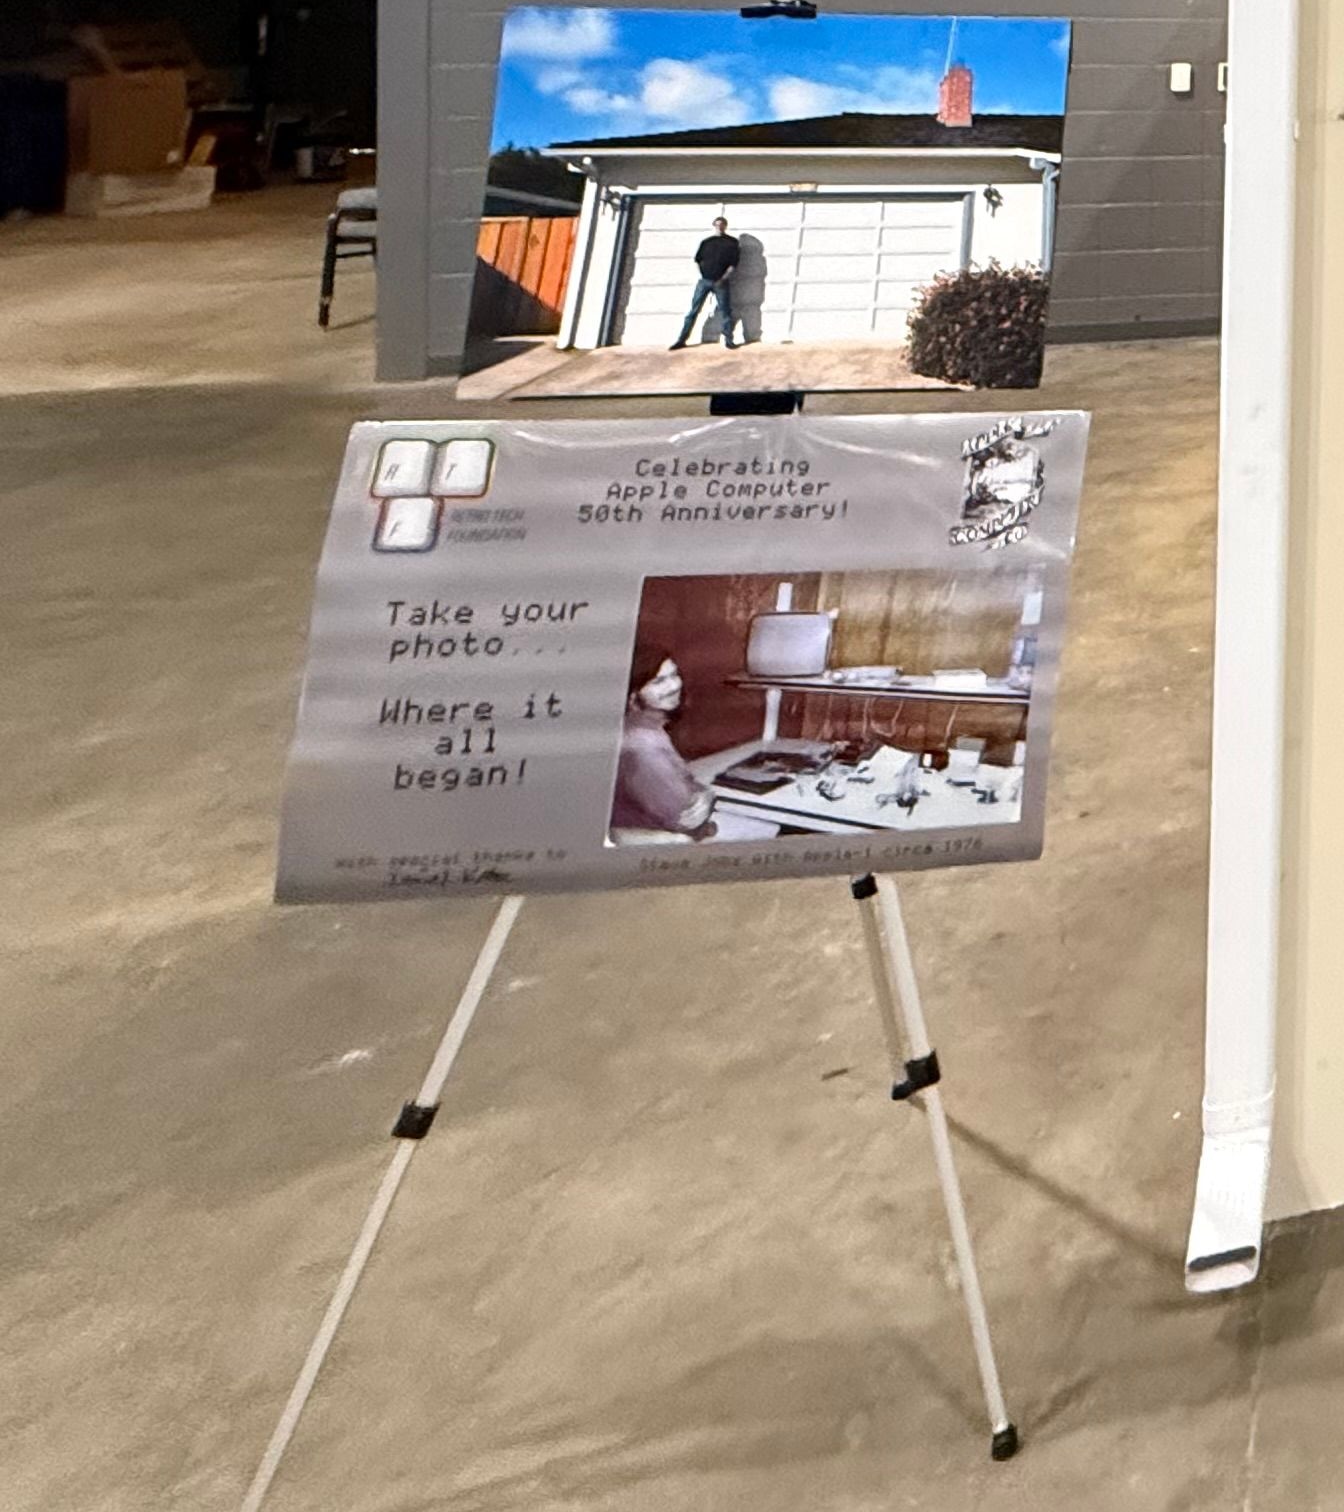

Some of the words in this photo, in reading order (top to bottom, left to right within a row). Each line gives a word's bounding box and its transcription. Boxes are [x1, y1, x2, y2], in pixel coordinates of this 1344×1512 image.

[634, 458, 811, 477] Celebrating
[606, 481, 688, 501] Apple
[705, 479, 831, 500] Computer
[576, 503, 643, 524] 50th
[660, 499, 850, 522] Anniversary!
[387, 600, 474, 627] Take
[501, 600, 589, 627] your
[389, 632, 566, 663] photo...
[379, 697, 494, 725] Where
[522, 692, 563, 720] it
[434, 726, 497, 755] all
[393, 757, 528, 792] began!
